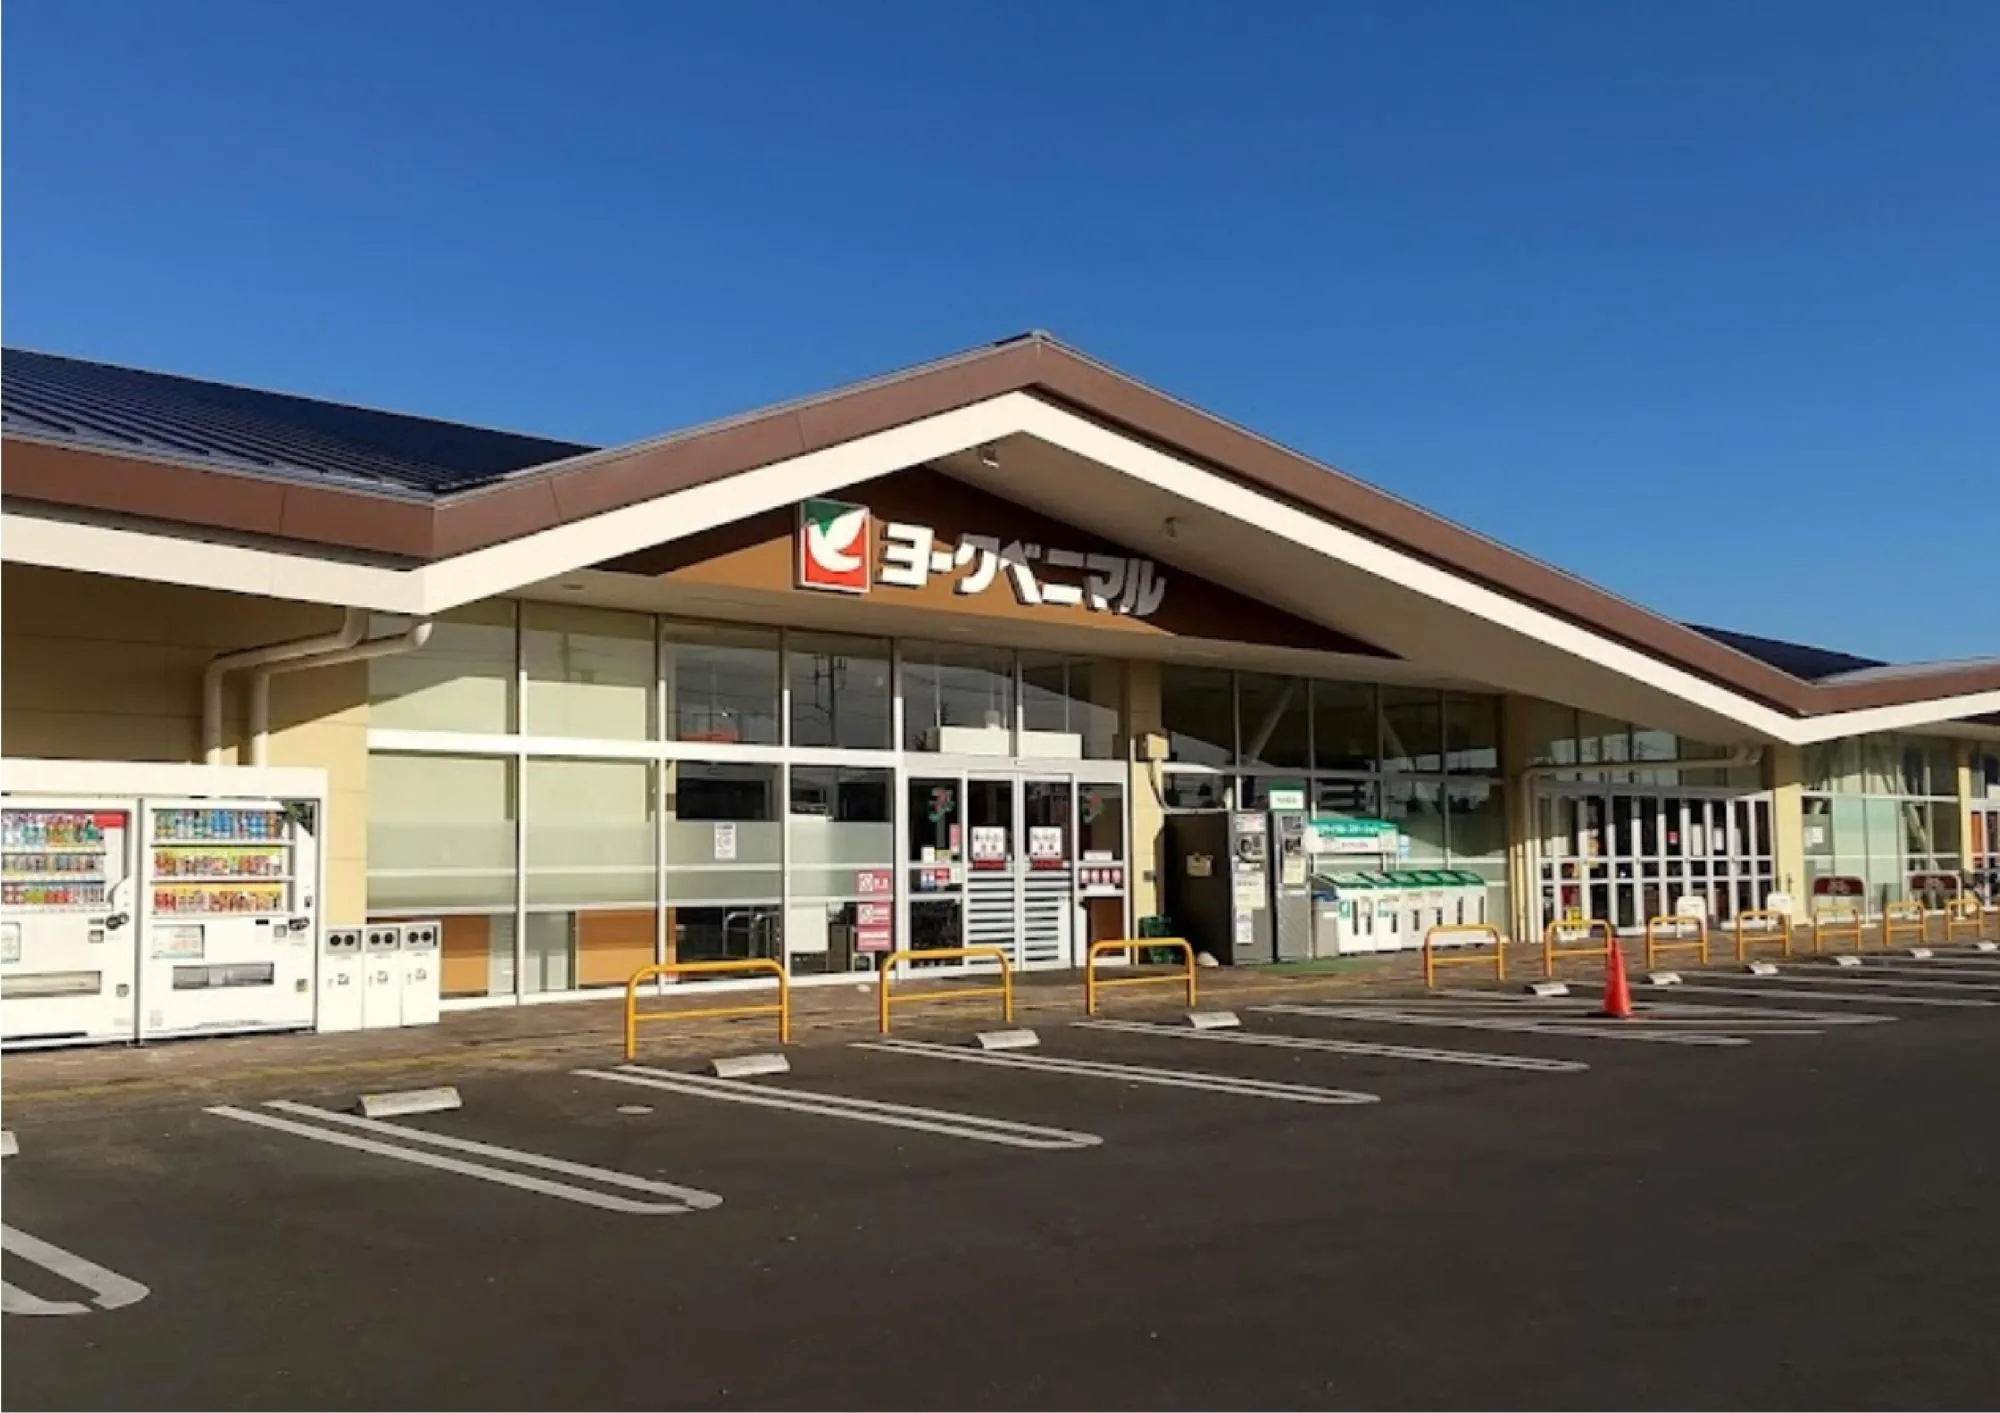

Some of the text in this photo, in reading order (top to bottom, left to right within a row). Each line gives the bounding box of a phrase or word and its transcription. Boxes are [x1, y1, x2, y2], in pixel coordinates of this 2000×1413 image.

[879, 521, 1167, 616] ヨークベニマル
